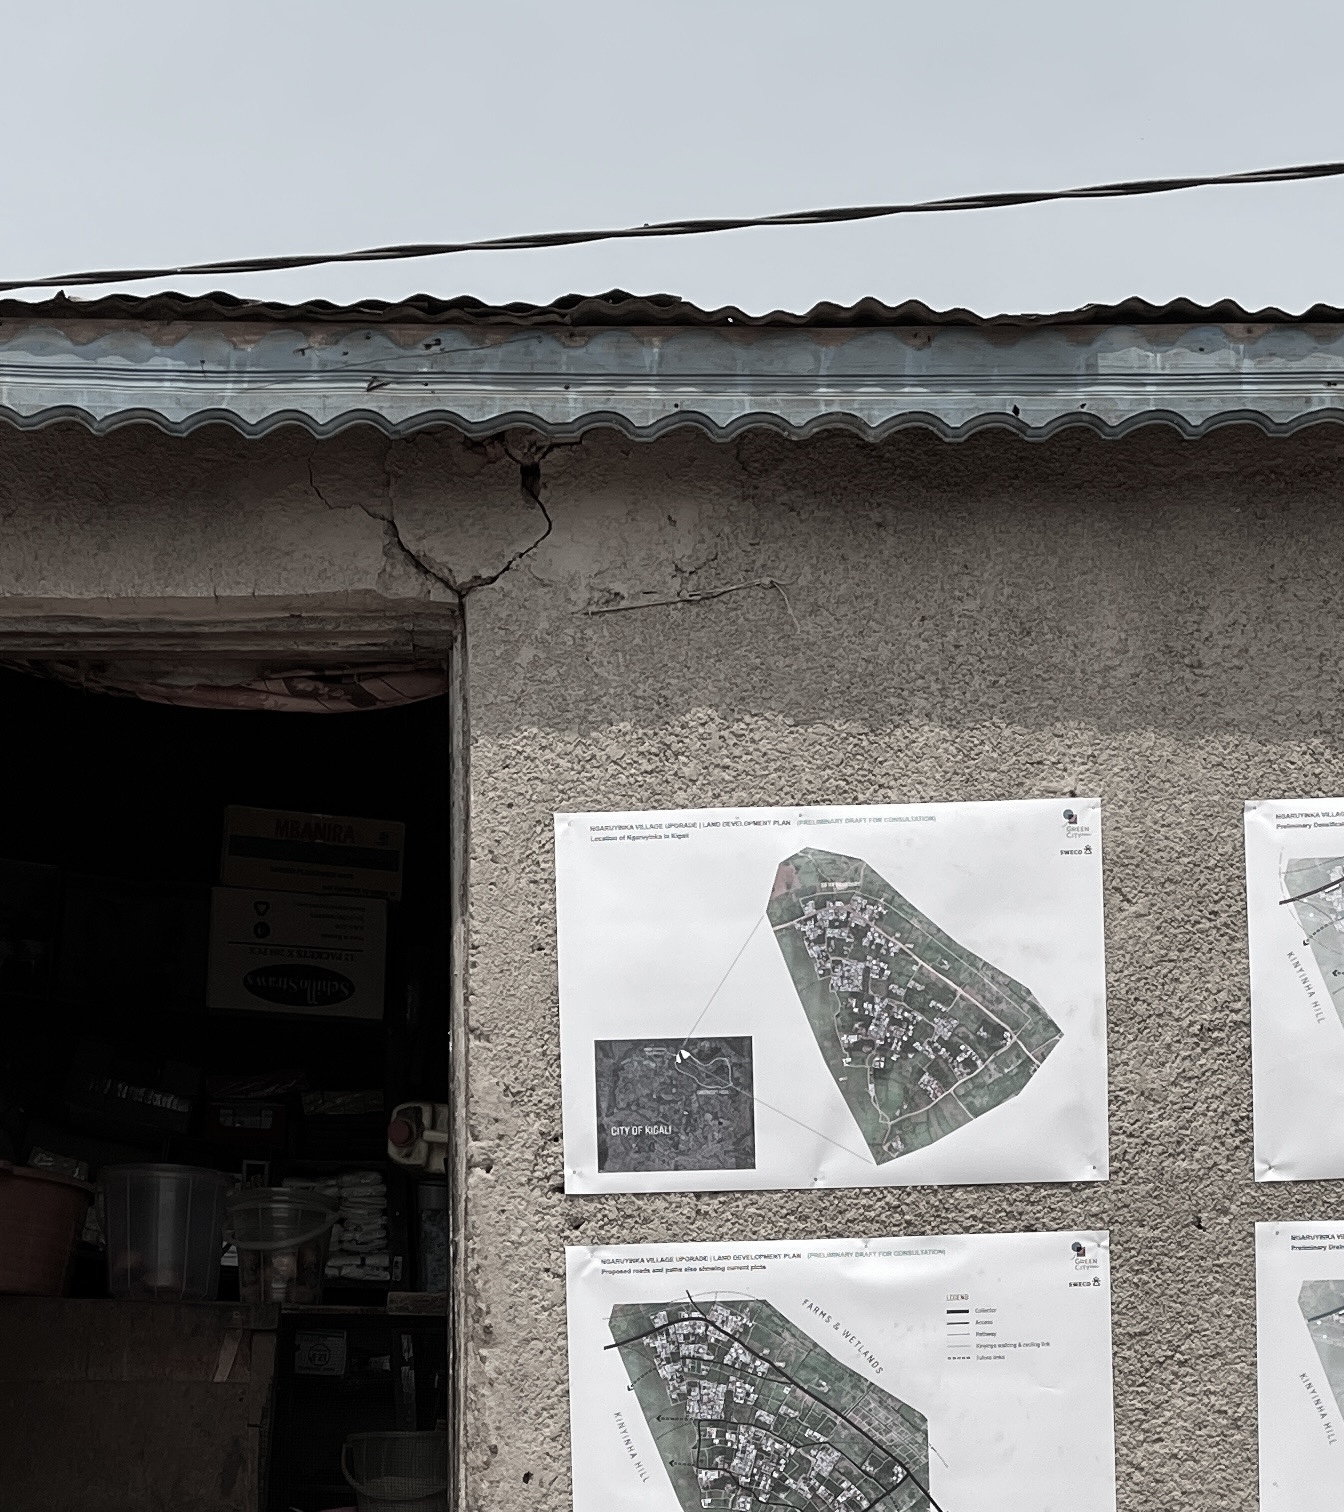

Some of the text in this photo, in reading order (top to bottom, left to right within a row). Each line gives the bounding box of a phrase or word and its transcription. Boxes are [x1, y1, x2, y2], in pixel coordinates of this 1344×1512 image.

[1312, 1001, 1325, 1024] HILL
[611, 1126, 672, 1136] CITY OF KIGALI
[802, 1299, 883, 1374] FARMS & WETLANDS
[1323, 1422, 1337, 1445] HILL
[634, 1461, 649, 1483] HILL
